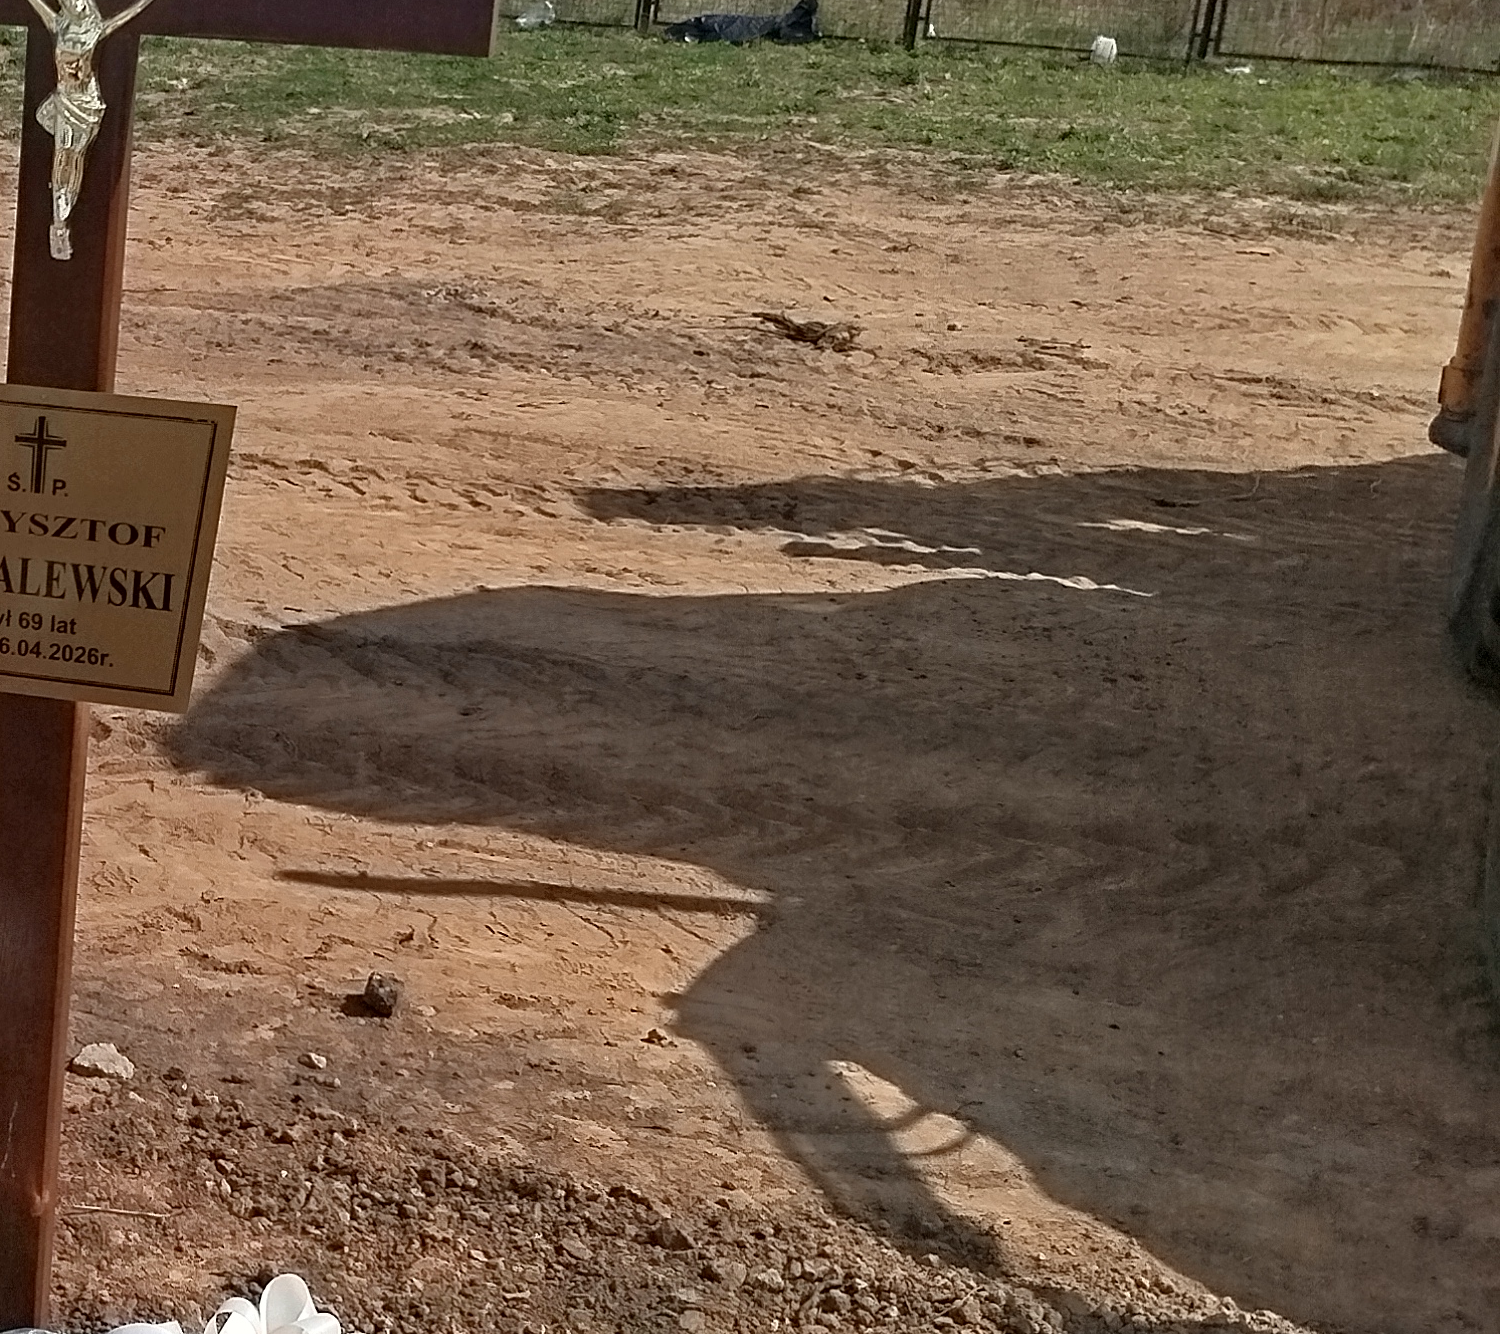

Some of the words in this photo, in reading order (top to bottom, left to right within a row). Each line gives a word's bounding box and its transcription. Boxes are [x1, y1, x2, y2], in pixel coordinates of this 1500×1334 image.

[7, 471, 26, 493] Ś.
[52, 478, 68, 497] P.
[18, 611, 43, 631] 69
[50, 615, 77, 636] lat
